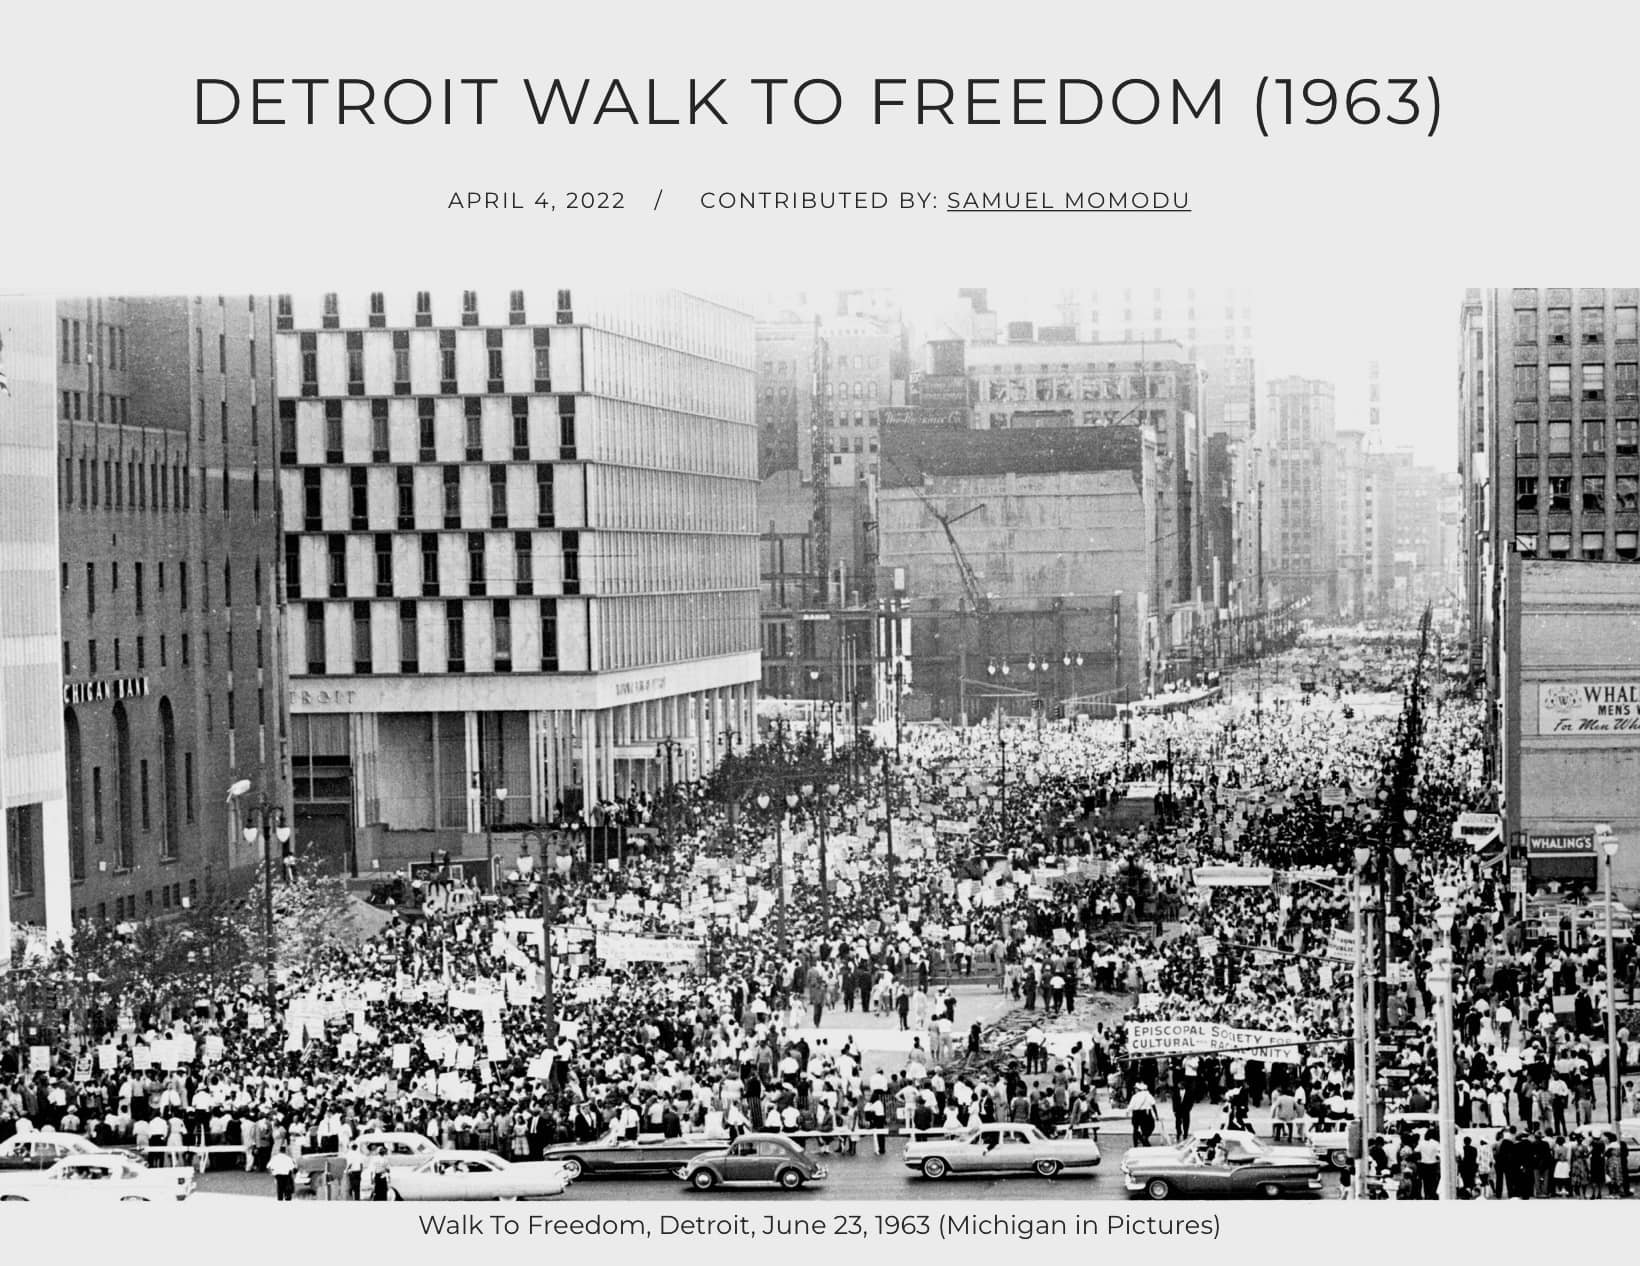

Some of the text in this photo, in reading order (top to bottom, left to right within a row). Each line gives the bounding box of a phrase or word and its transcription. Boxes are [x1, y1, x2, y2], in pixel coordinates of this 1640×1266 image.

[64, 681, 110, 704] CHIGAN
[1578, 718, 1609, 731] Men
[1531, 836, 1592, 849] WHALING'S
[1134, 1025, 1205, 1037] EPISCOPAL
[1211, 1025, 1263, 1044] SOCIETY
[1132, 1037, 1196, 1049] CULTURAL
